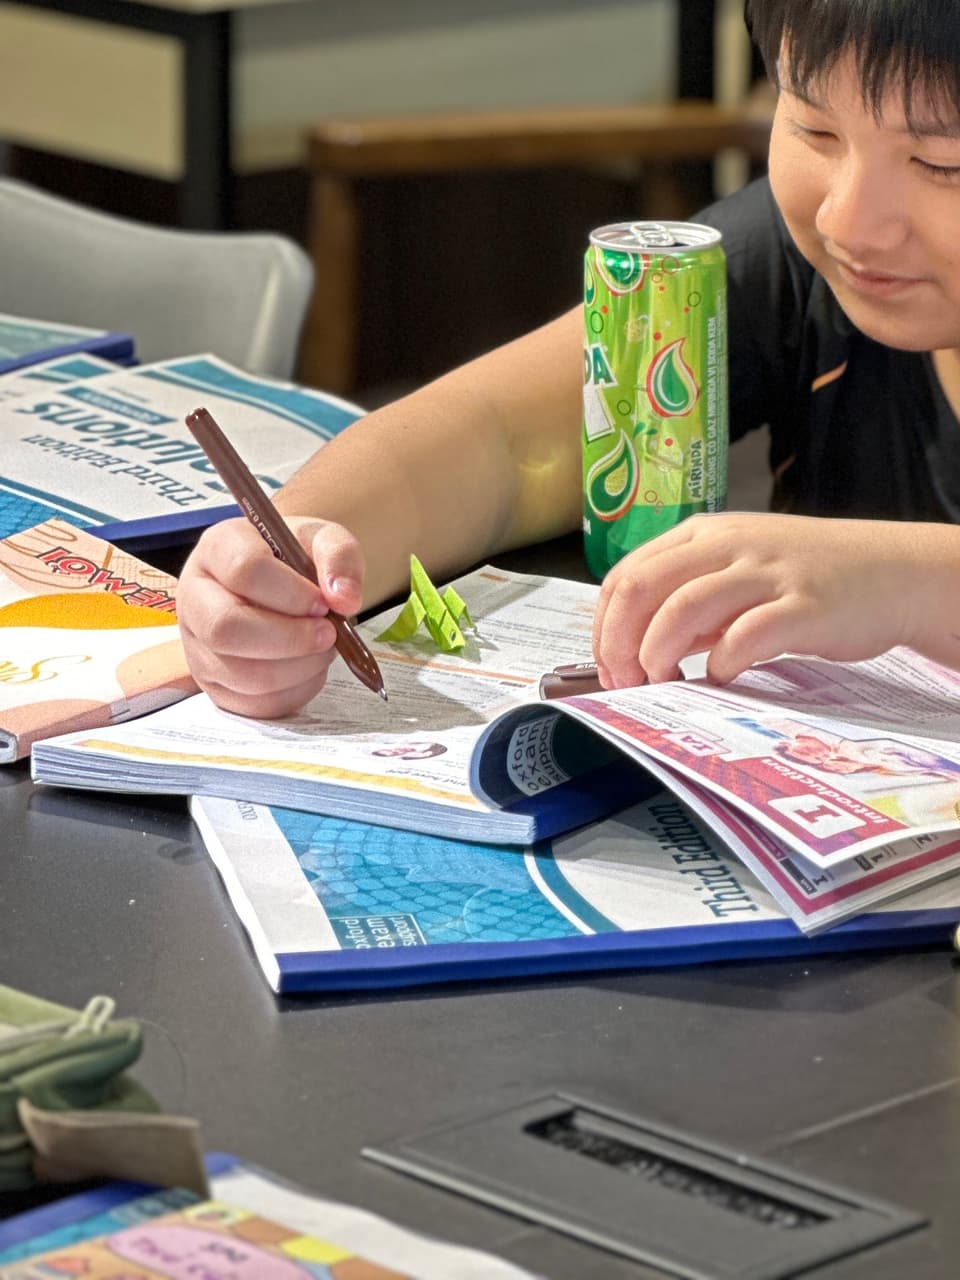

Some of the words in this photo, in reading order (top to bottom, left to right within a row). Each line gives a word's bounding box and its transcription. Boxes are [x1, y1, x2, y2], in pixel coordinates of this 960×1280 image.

[21, 433, 128, 471] Edition
[111, 465, 208, 507] Third
[760, 757, 890, 825] Introduction
[647, 802, 720, 865] Edition
[679, 865, 759, 918] Third
[339, 918, 371, 950] oxford
[366, 917, 396, 949] exam
